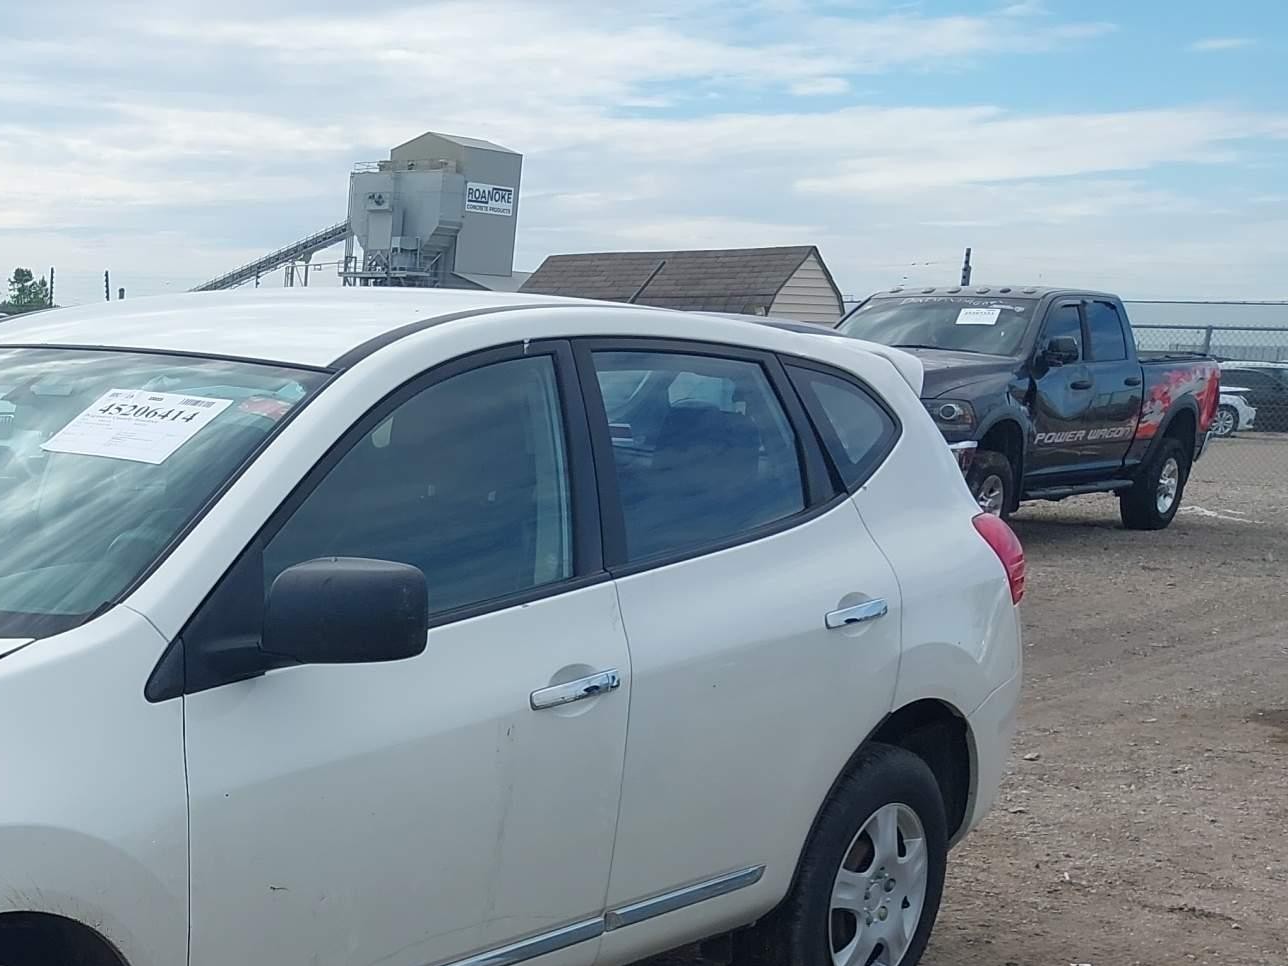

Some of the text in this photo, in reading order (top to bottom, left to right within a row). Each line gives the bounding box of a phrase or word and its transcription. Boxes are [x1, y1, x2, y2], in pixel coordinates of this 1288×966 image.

[468, 188, 512, 203] ROANOKE
[99, 403, 200, 422] 45206414
[1034, 427, 1132, 444] POWER WAGON
